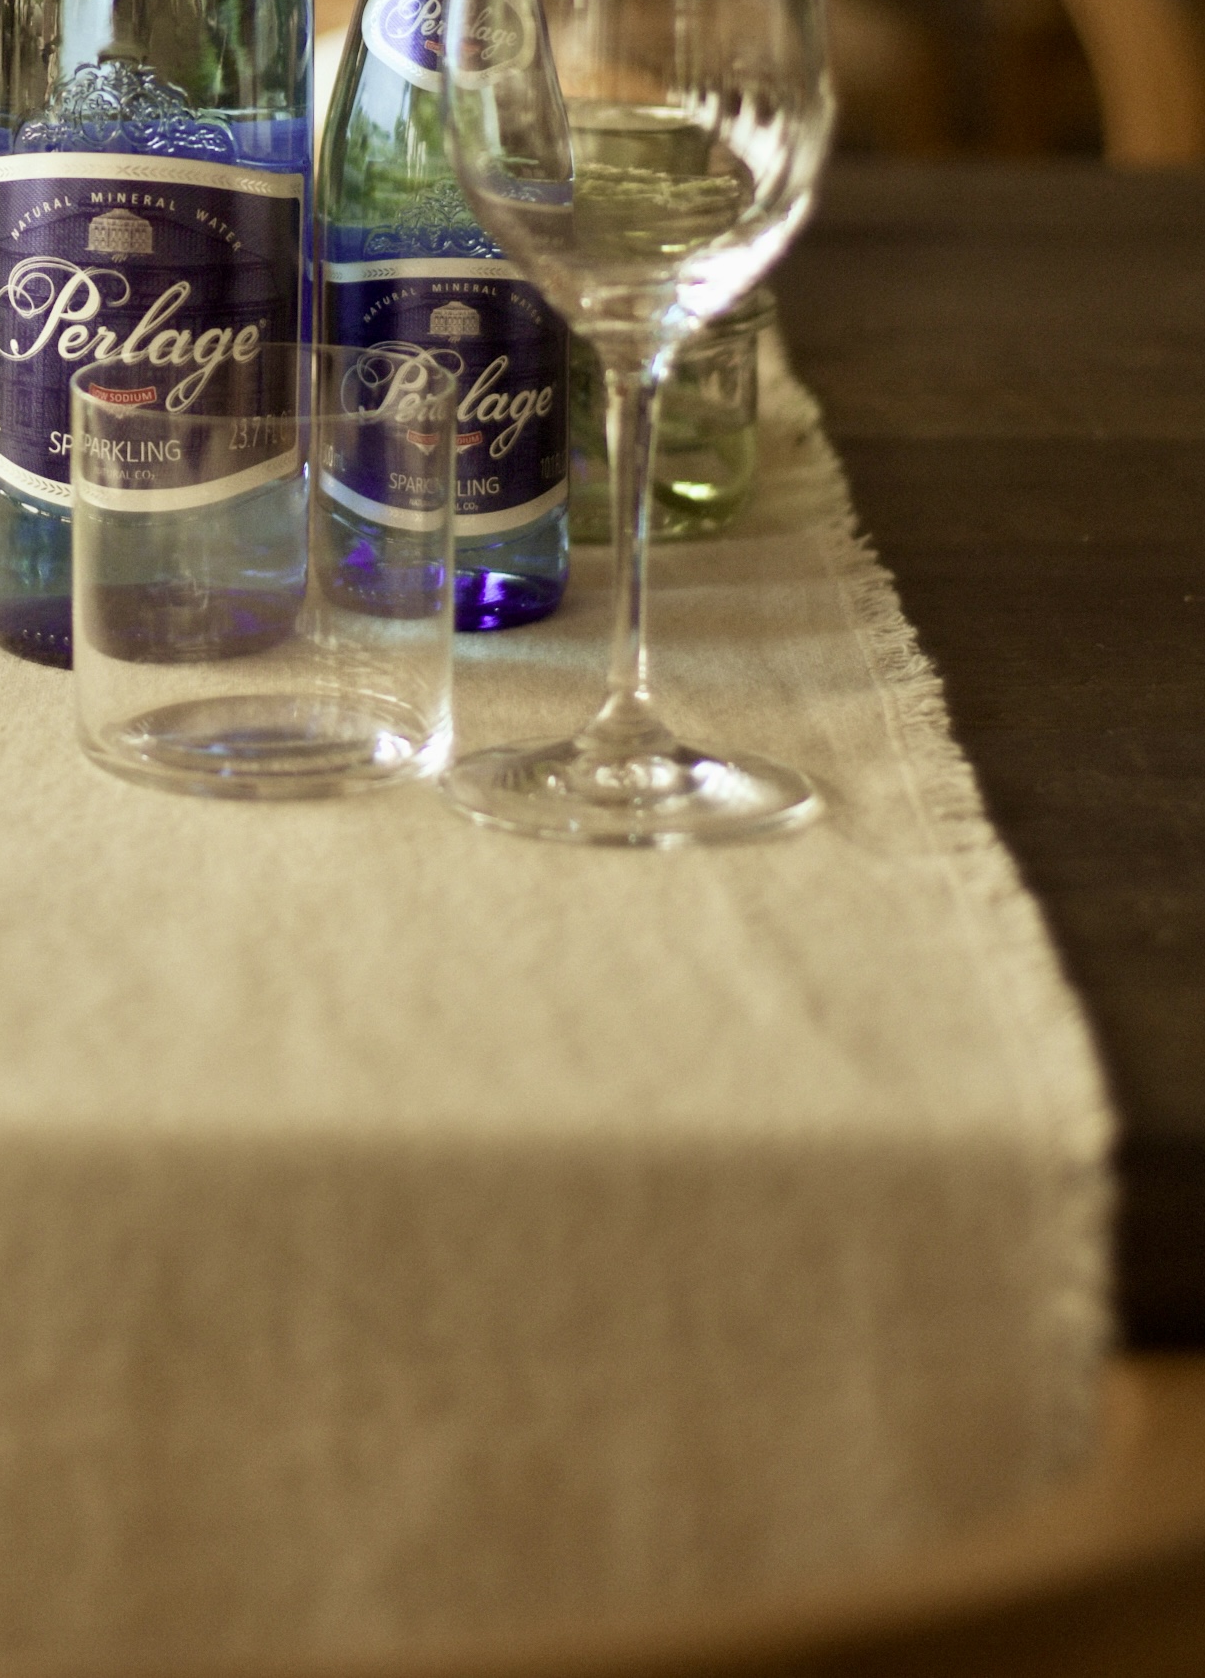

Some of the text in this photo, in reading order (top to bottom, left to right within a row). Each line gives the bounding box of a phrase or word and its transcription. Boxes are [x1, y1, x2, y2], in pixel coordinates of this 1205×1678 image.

[11, 192, 242, 252] NATURAL MINERAL WATER
[363, 283, 543, 324] NATURAL MINERAL WATER
[109, 390, 153, 403] SODIUM
[341, 340, 554, 459] Perlage
